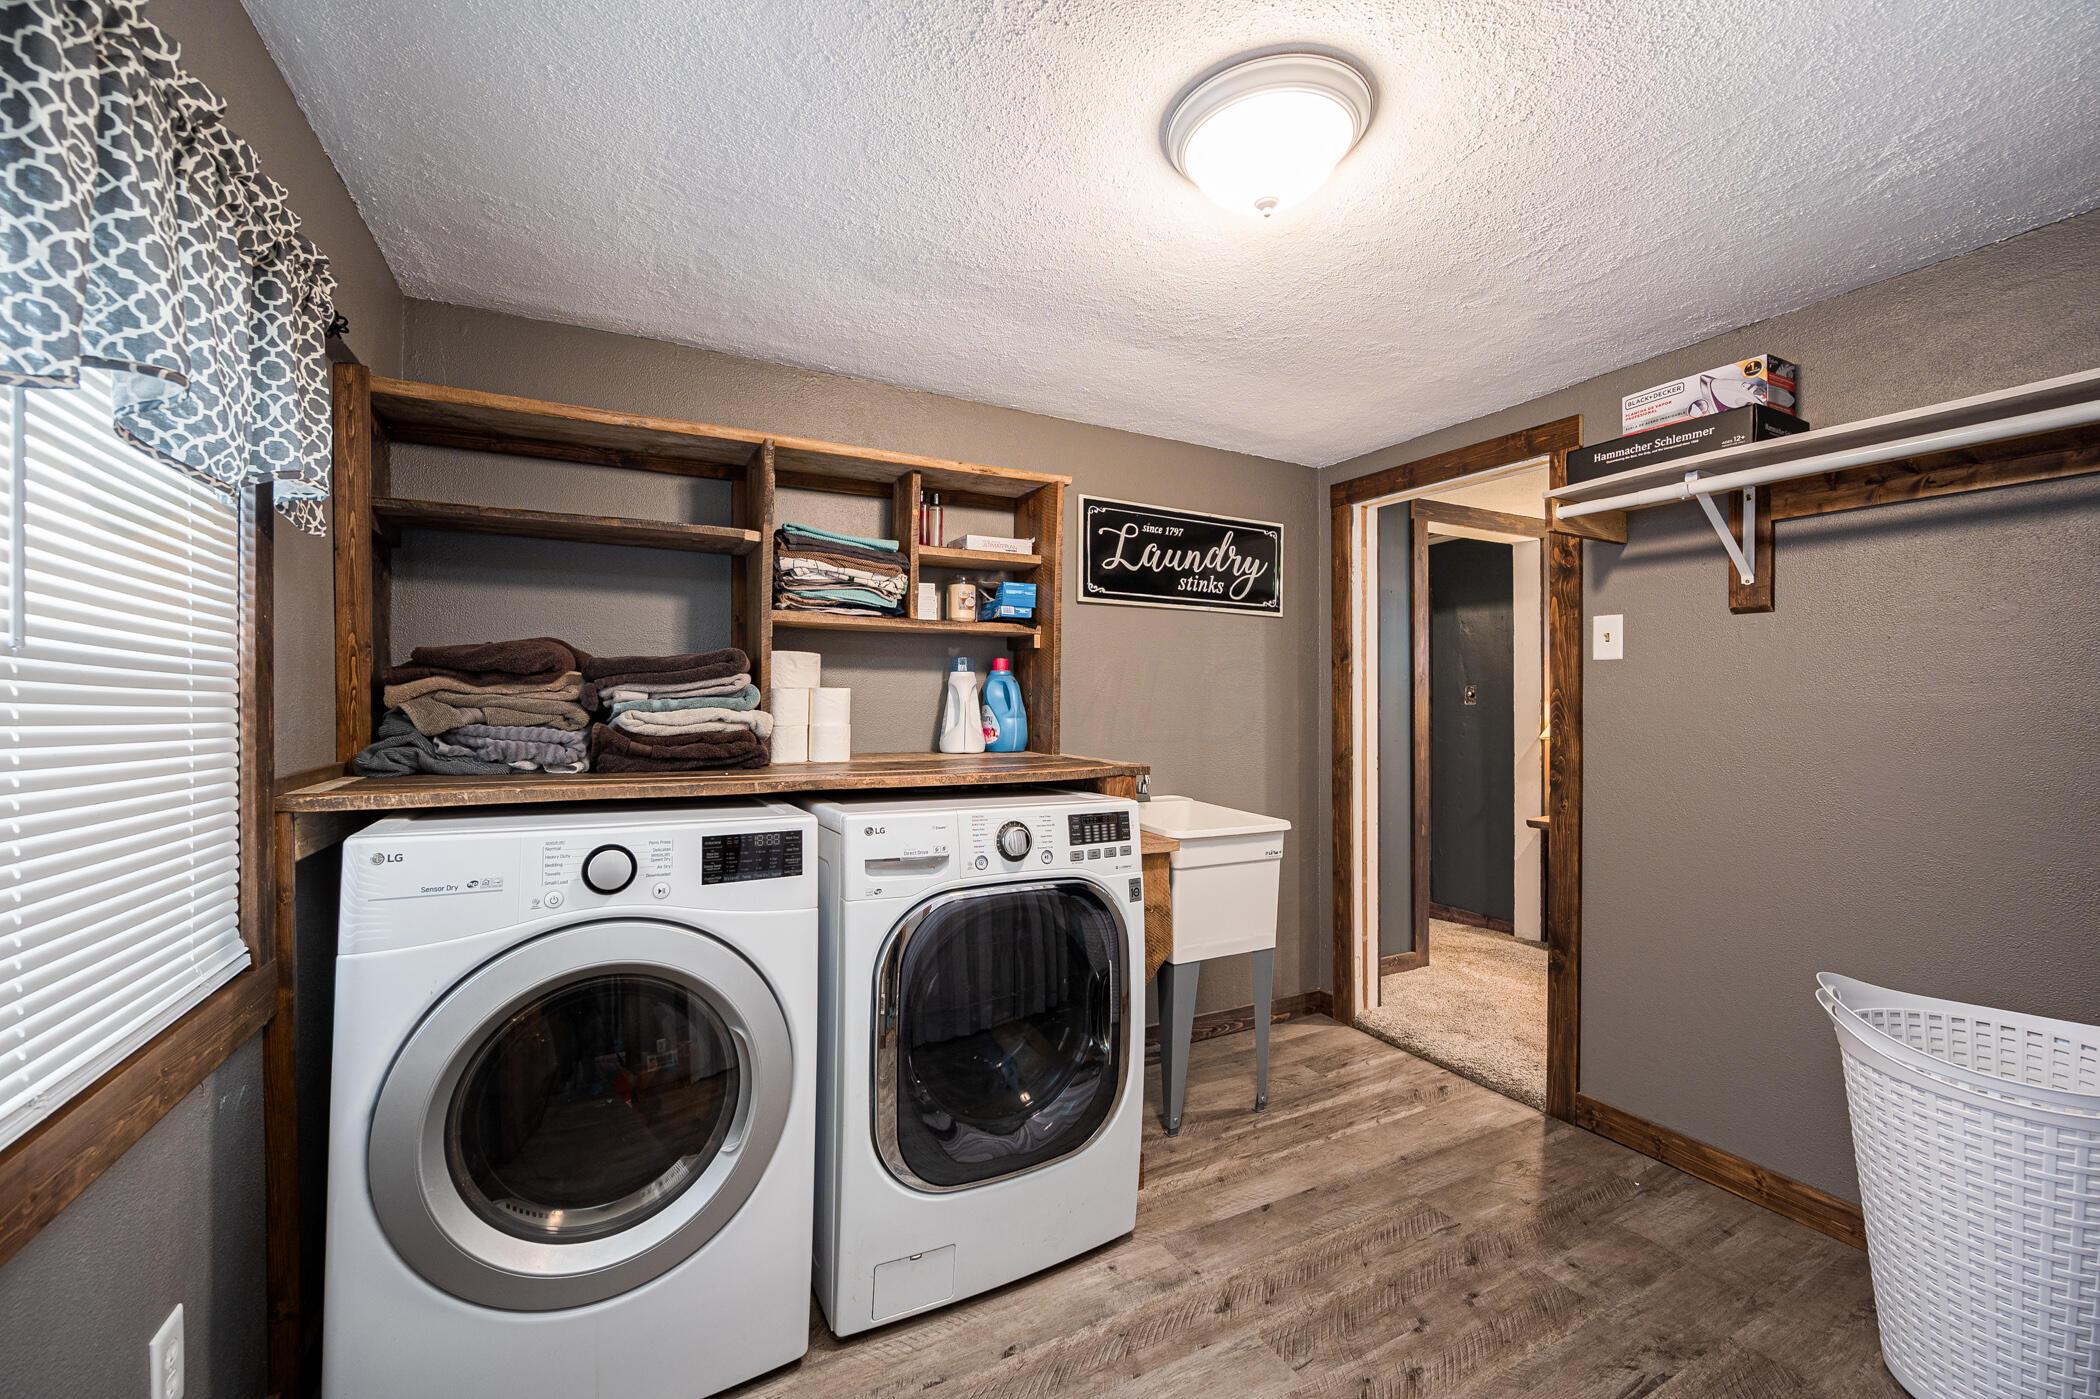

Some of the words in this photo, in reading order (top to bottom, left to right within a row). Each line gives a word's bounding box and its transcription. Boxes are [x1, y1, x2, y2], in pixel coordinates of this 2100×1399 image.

[1627, 385, 1682, 407] BLACK+DECKER
[1594, 442, 1653, 462] Hammacher
[1654, 427, 1716, 448] Schlemmer
[1142, 522, 1163, 534] since
[1164, 526, 1185, 537] 1797
[1098, 522, 1269, 600] Laundry
[1177, 575, 1225, 595] stinks
[387, 853, 403, 863] LG
[420, 885, 445, 893] Sensor
